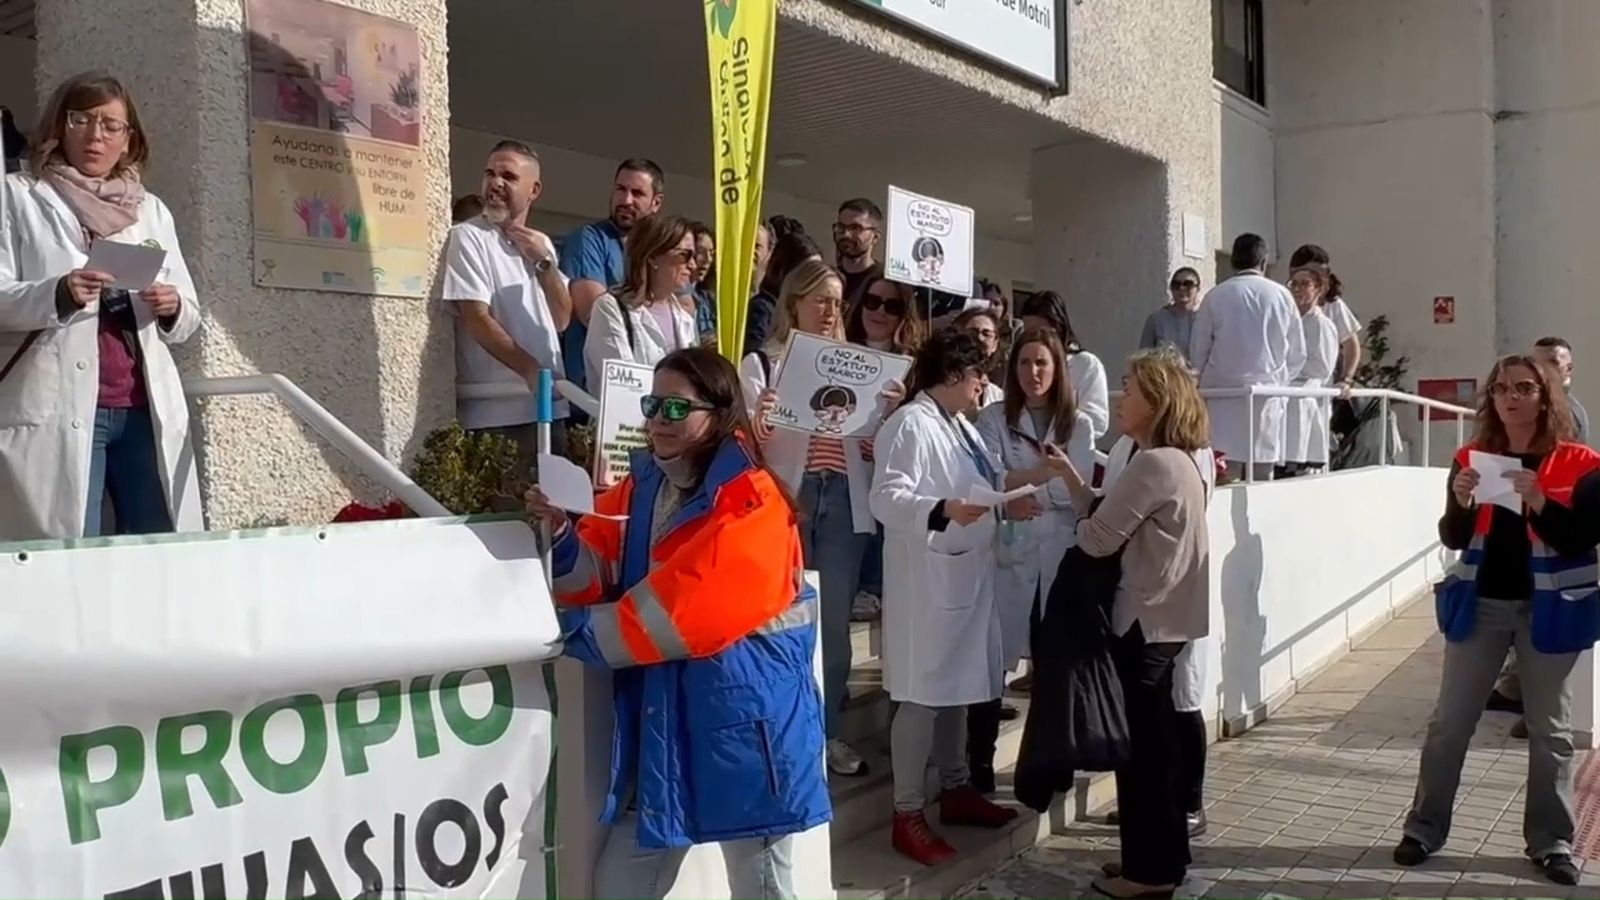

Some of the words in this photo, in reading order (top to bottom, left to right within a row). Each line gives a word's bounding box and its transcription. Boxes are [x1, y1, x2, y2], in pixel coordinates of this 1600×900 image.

[1018, 0, 1051, 29] Motril
[272, 154, 297, 166] este
[300, 157, 345, 174] CENTRO
[355, 150, 414, 169] mantener
[372, 182, 398, 198] libre
[400, 189, 415, 200] de
[719, 167, 741, 205] de
[910, 209, 950, 225] ESTATUTO
[821, 354, 878, 375] ESTATUTO
[834, 348, 850, 360] NO
[853, 353, 866, 364] AL
[827, 366, 867, 380] MARCO!
[58, 664, 515, 845] PROPIO
